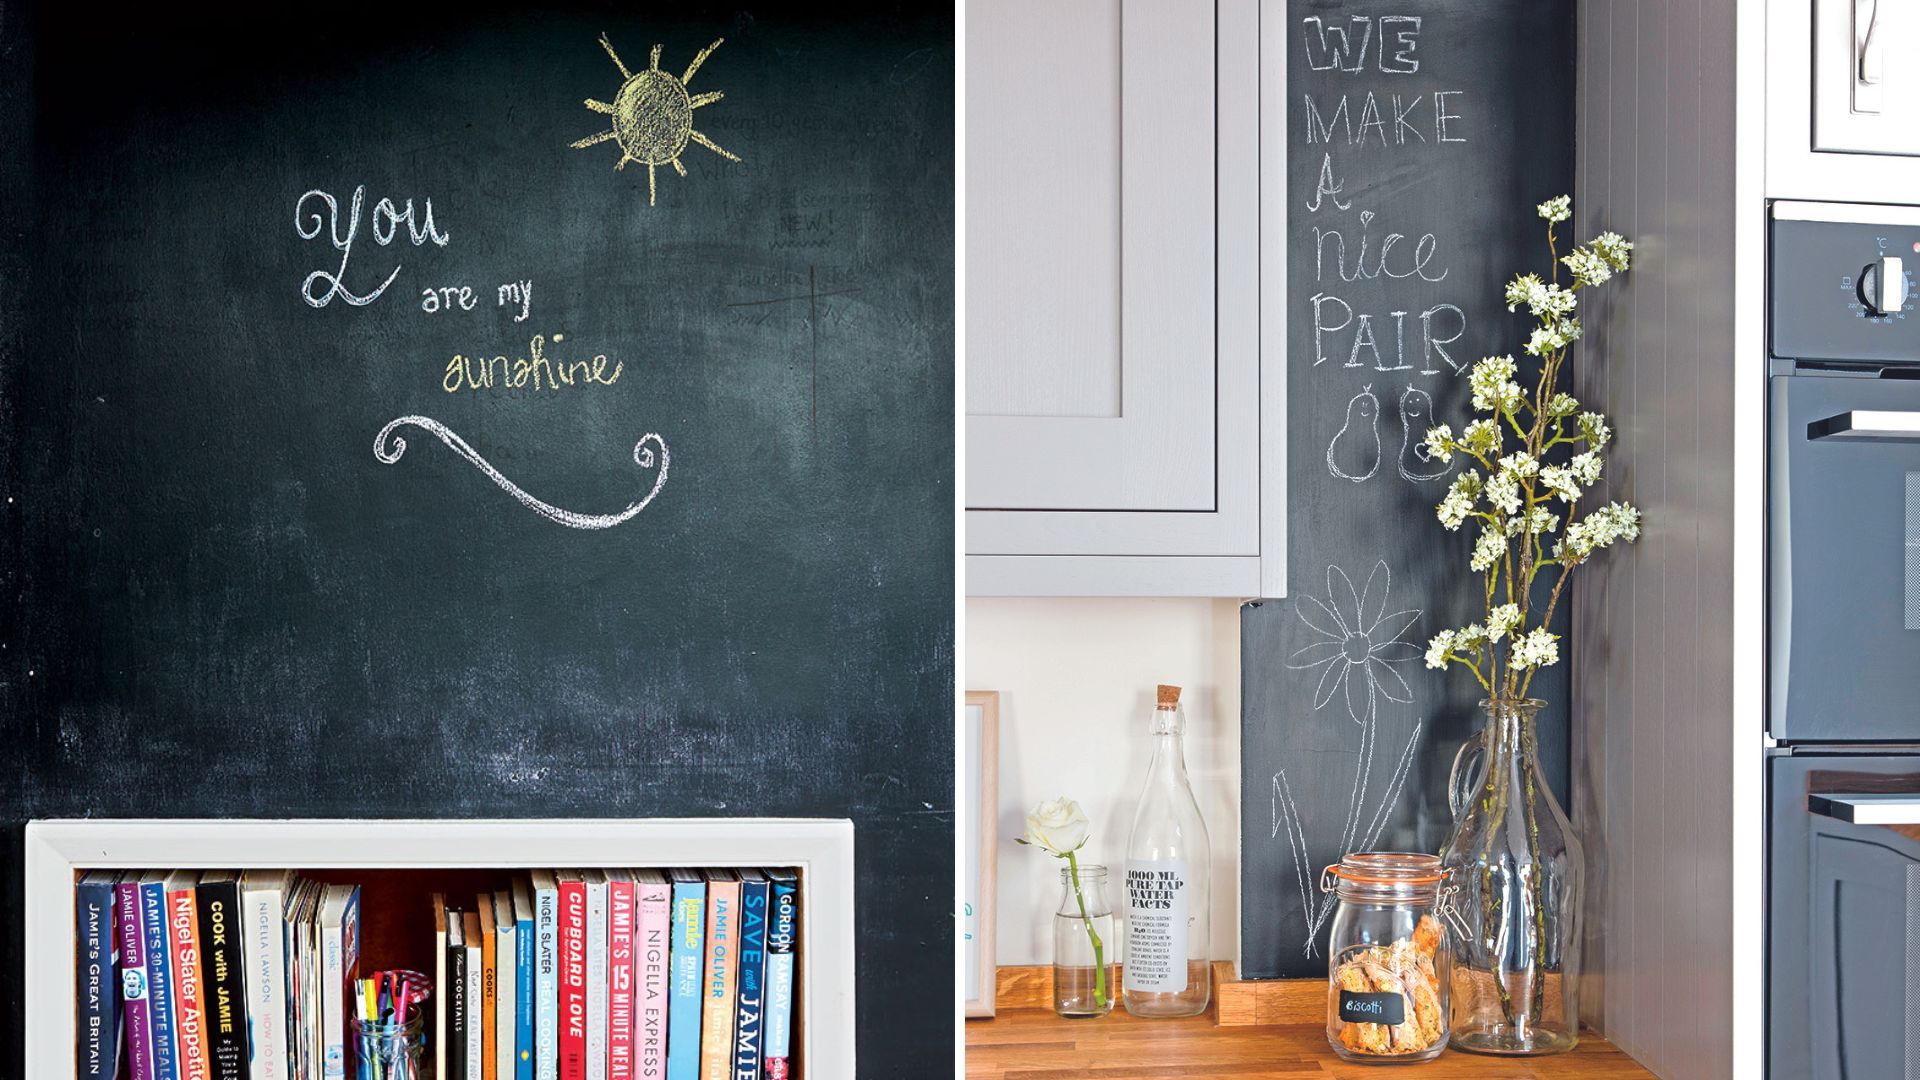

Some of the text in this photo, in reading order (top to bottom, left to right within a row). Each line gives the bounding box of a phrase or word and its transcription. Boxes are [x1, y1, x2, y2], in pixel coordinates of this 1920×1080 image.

[1303, 15, 1421, 74] WE
[1304, 91, 1466, 147] MAKE
[1306, 153, 1351, 212] A
[295, 185, 449, 308] You
[1312, 210, 1448, 282] nice
[422, 280, 532, 322] are my
[443, 334, 624, 392] sunshine
[1310, 293, 1468, 376] PAIR
[1126, 879, 1184, 890] PURE TAP
[1128, 870, 1179, 880] 1000 ML
[1130, 889, 1174, 900] WATER
[1132, 898, 1171, 909] FACTS
[121, 888, 137, 964] JAMIE OLIVER
[146, 889, 162, 949] JAMIE'S
[174, 897, 194, 945] Nigel
[569, 892, 583, 987] CUPBOARD
[613, 890, 630, 959] JAMIE'S
[683, 897, 703, 949] jamie
[714, 898, 728, 941] JAMIE
[777, 894, 792, 953] GORDON
[88, 903, 101, 1074] JAMIE'S GREAT BRITAIN
[151, 952, 168, 1032] 30-MINUTE
[180, 949, 197, 1002] Slater
[211, 901, 233, 1033] COOK with JAMIE
[259, 902, 273, 1079] NIGELLA LAWSON HOW TO EAT
[541, 895, 551, 1079] NIGEL SLATER REAL COOKING
[613, 964, 630, 991] 15
[646, 930, 661, 1000] NIGELLA
[713, 945, 727, 998] OLIVER
[738, 895, 765, 1080] SAVE with JAMIE
[775, 953, 790, 1012] RAMSAY
[569, 993, 583, 1038] LOVE
[612, 993, 629, 1042] MINUTE
[644, 1008, 659, 1076] EXPRESS
